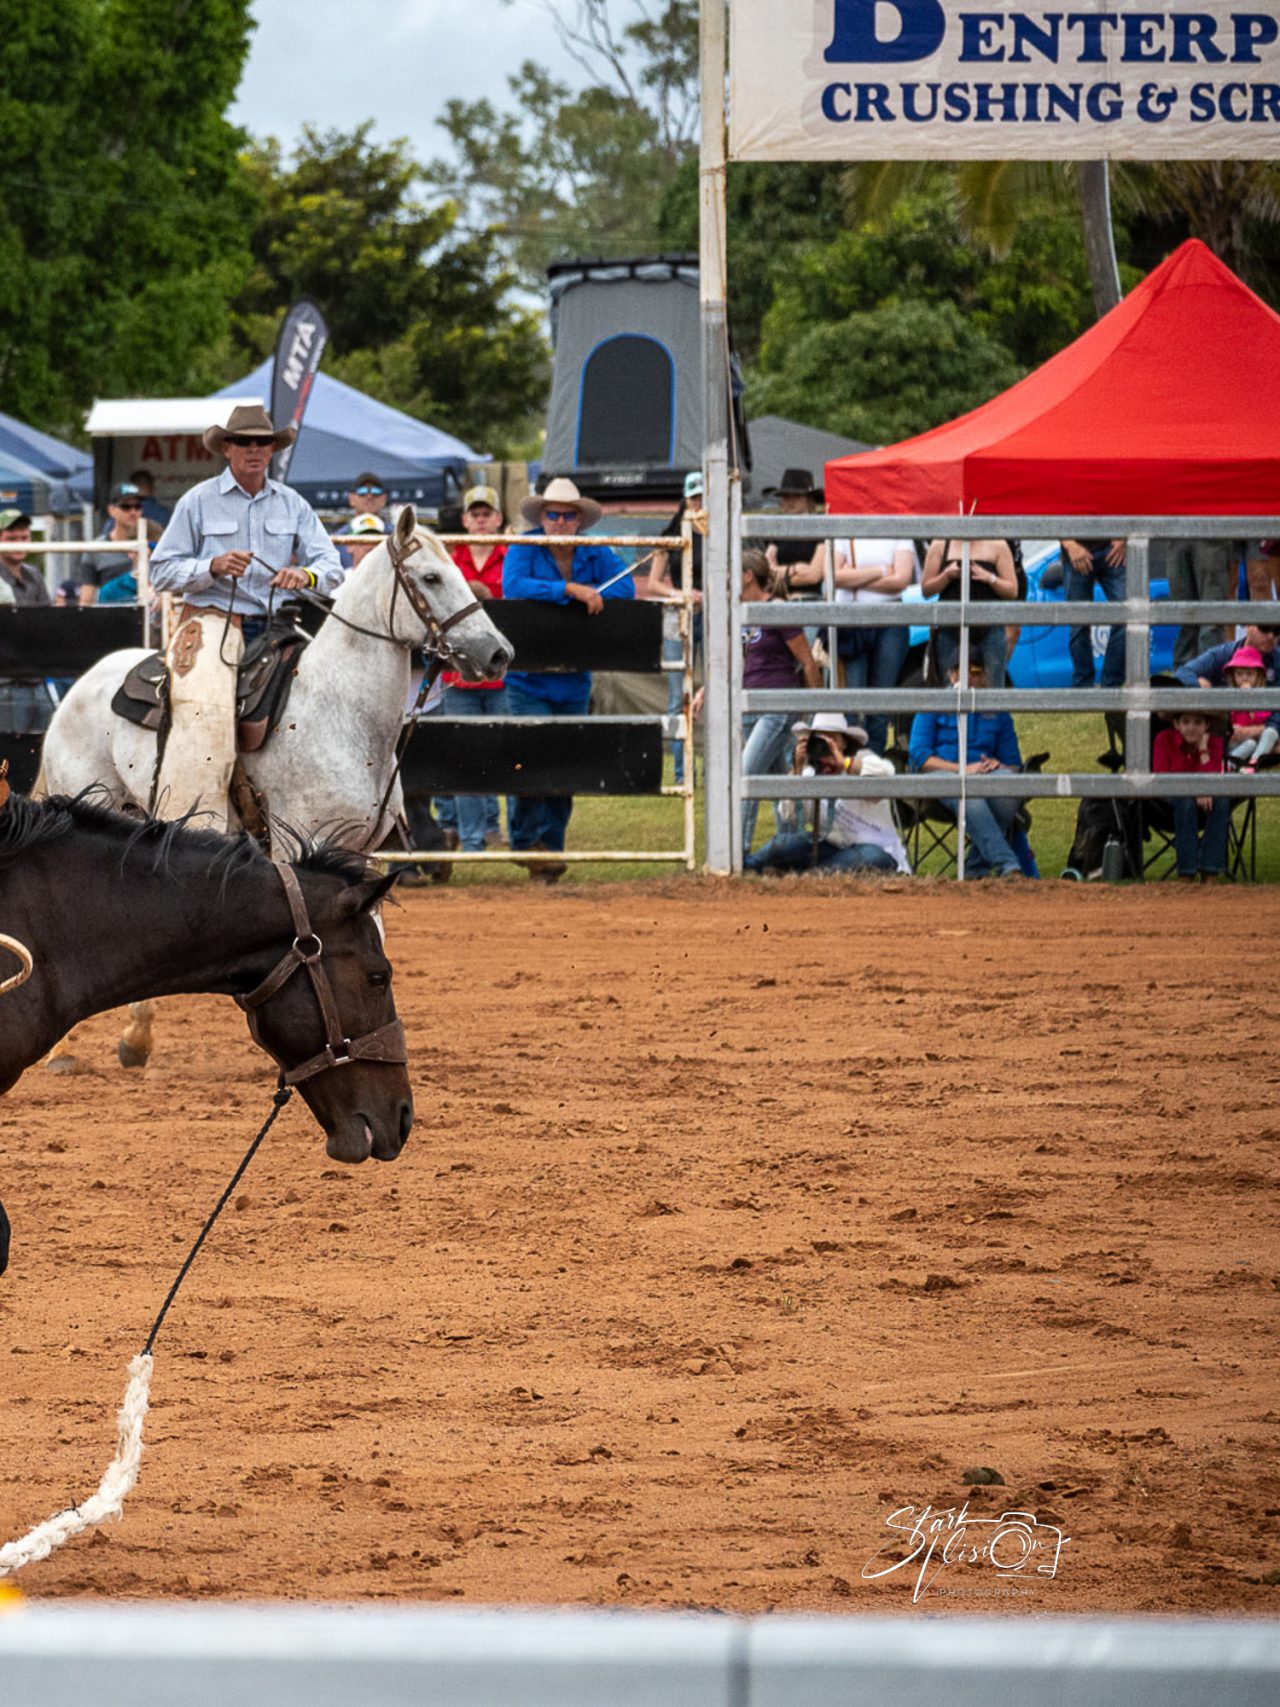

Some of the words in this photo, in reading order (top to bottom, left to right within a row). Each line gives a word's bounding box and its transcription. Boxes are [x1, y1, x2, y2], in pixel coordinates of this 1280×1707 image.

[821, 83, 1124, 123] CRUSHING
[1137, 82, 1178, 123] &
[282, 323, 317, 391] MTA
[142, 435, 214, 463] ATM
